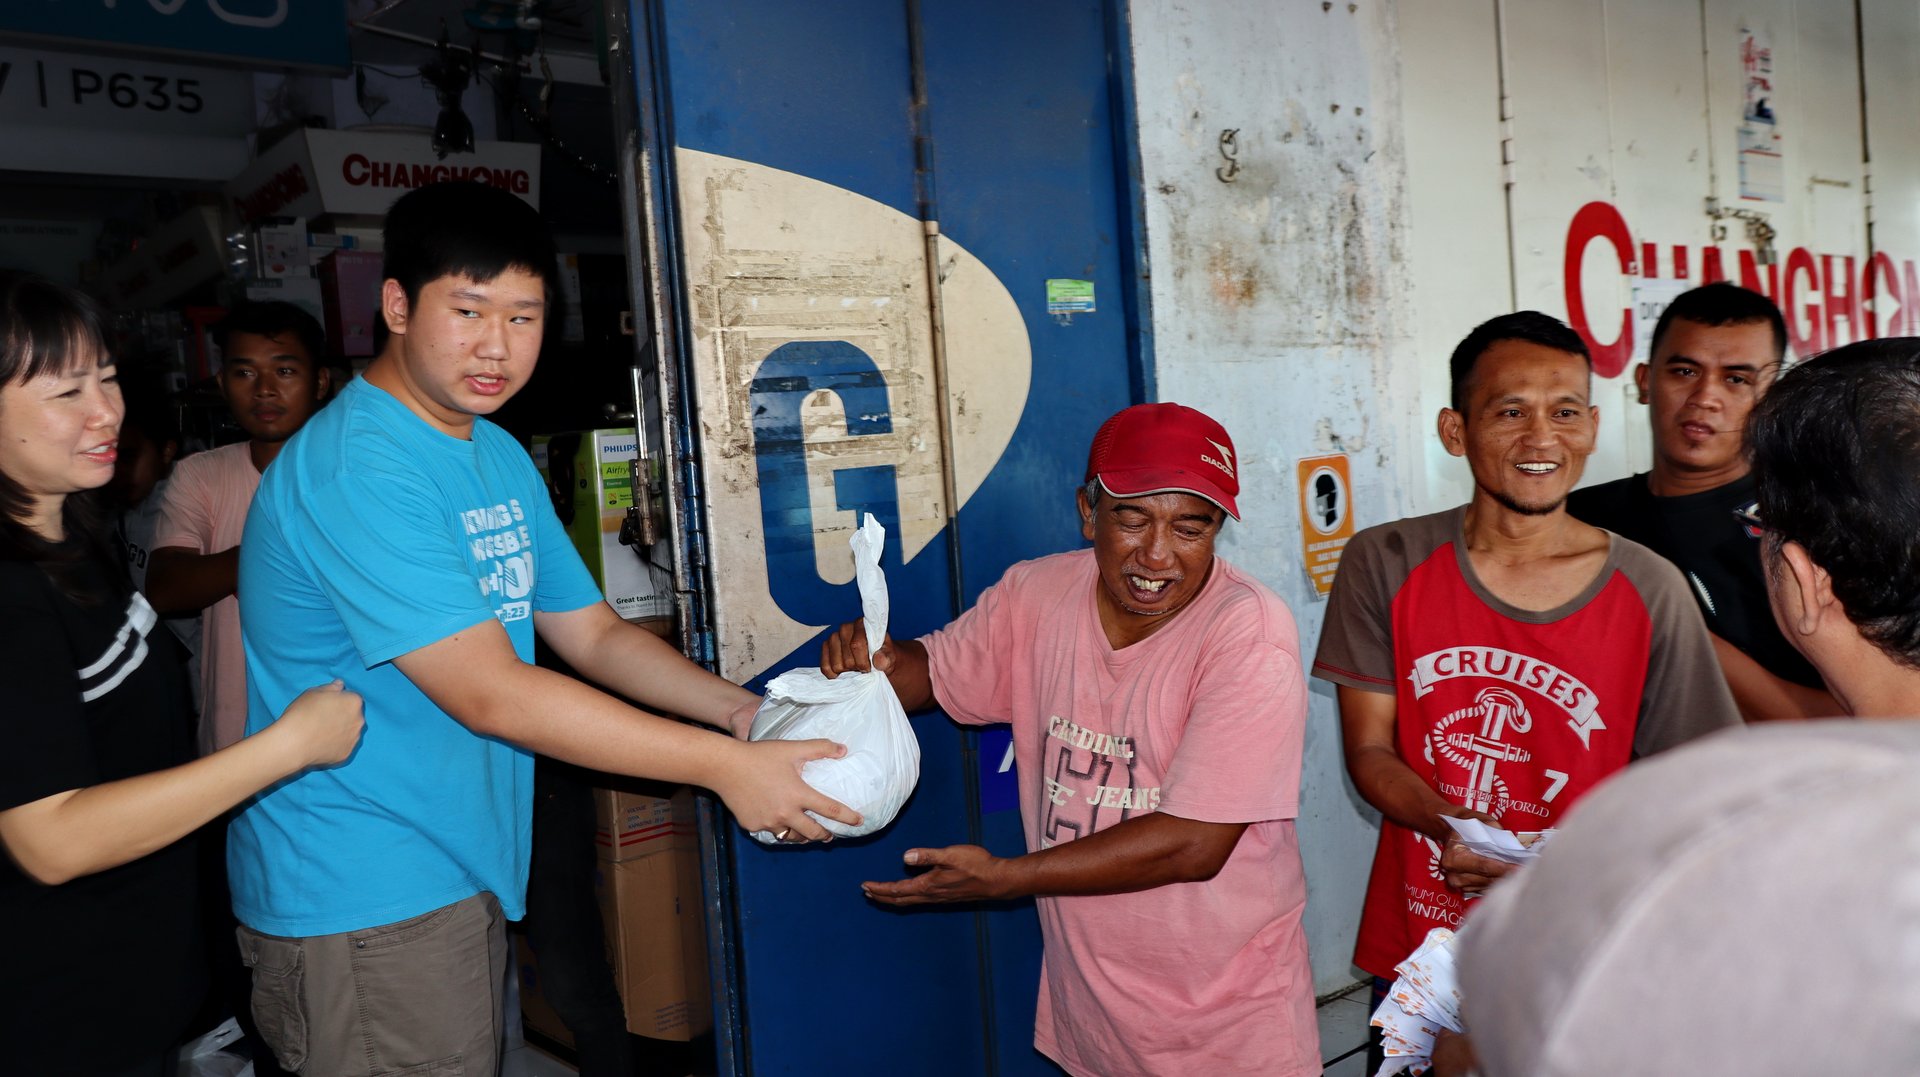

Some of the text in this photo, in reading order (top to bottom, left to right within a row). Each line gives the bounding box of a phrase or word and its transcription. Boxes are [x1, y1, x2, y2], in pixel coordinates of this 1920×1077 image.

[71, 68, 203, 114] P635
[342, 153, 530, 194] CHANGHONG
[603, 443, 638, 454] PHILIPS
[606, 466, 628, 475] Airfry
[1200, 454, 1235, 480] DIADORA
[615, 596, 635, 605] Great
[1433, 650, 1588, 710] CRUISES
[1086, 785, 1161, 811] JEANS
[1541, 768, 1569, 804] 7
[1470, 788, 1497, 805] THE
[1498, 797, 1550, 818] WORLD
[1404, 882, 1435, 903] MIUM
